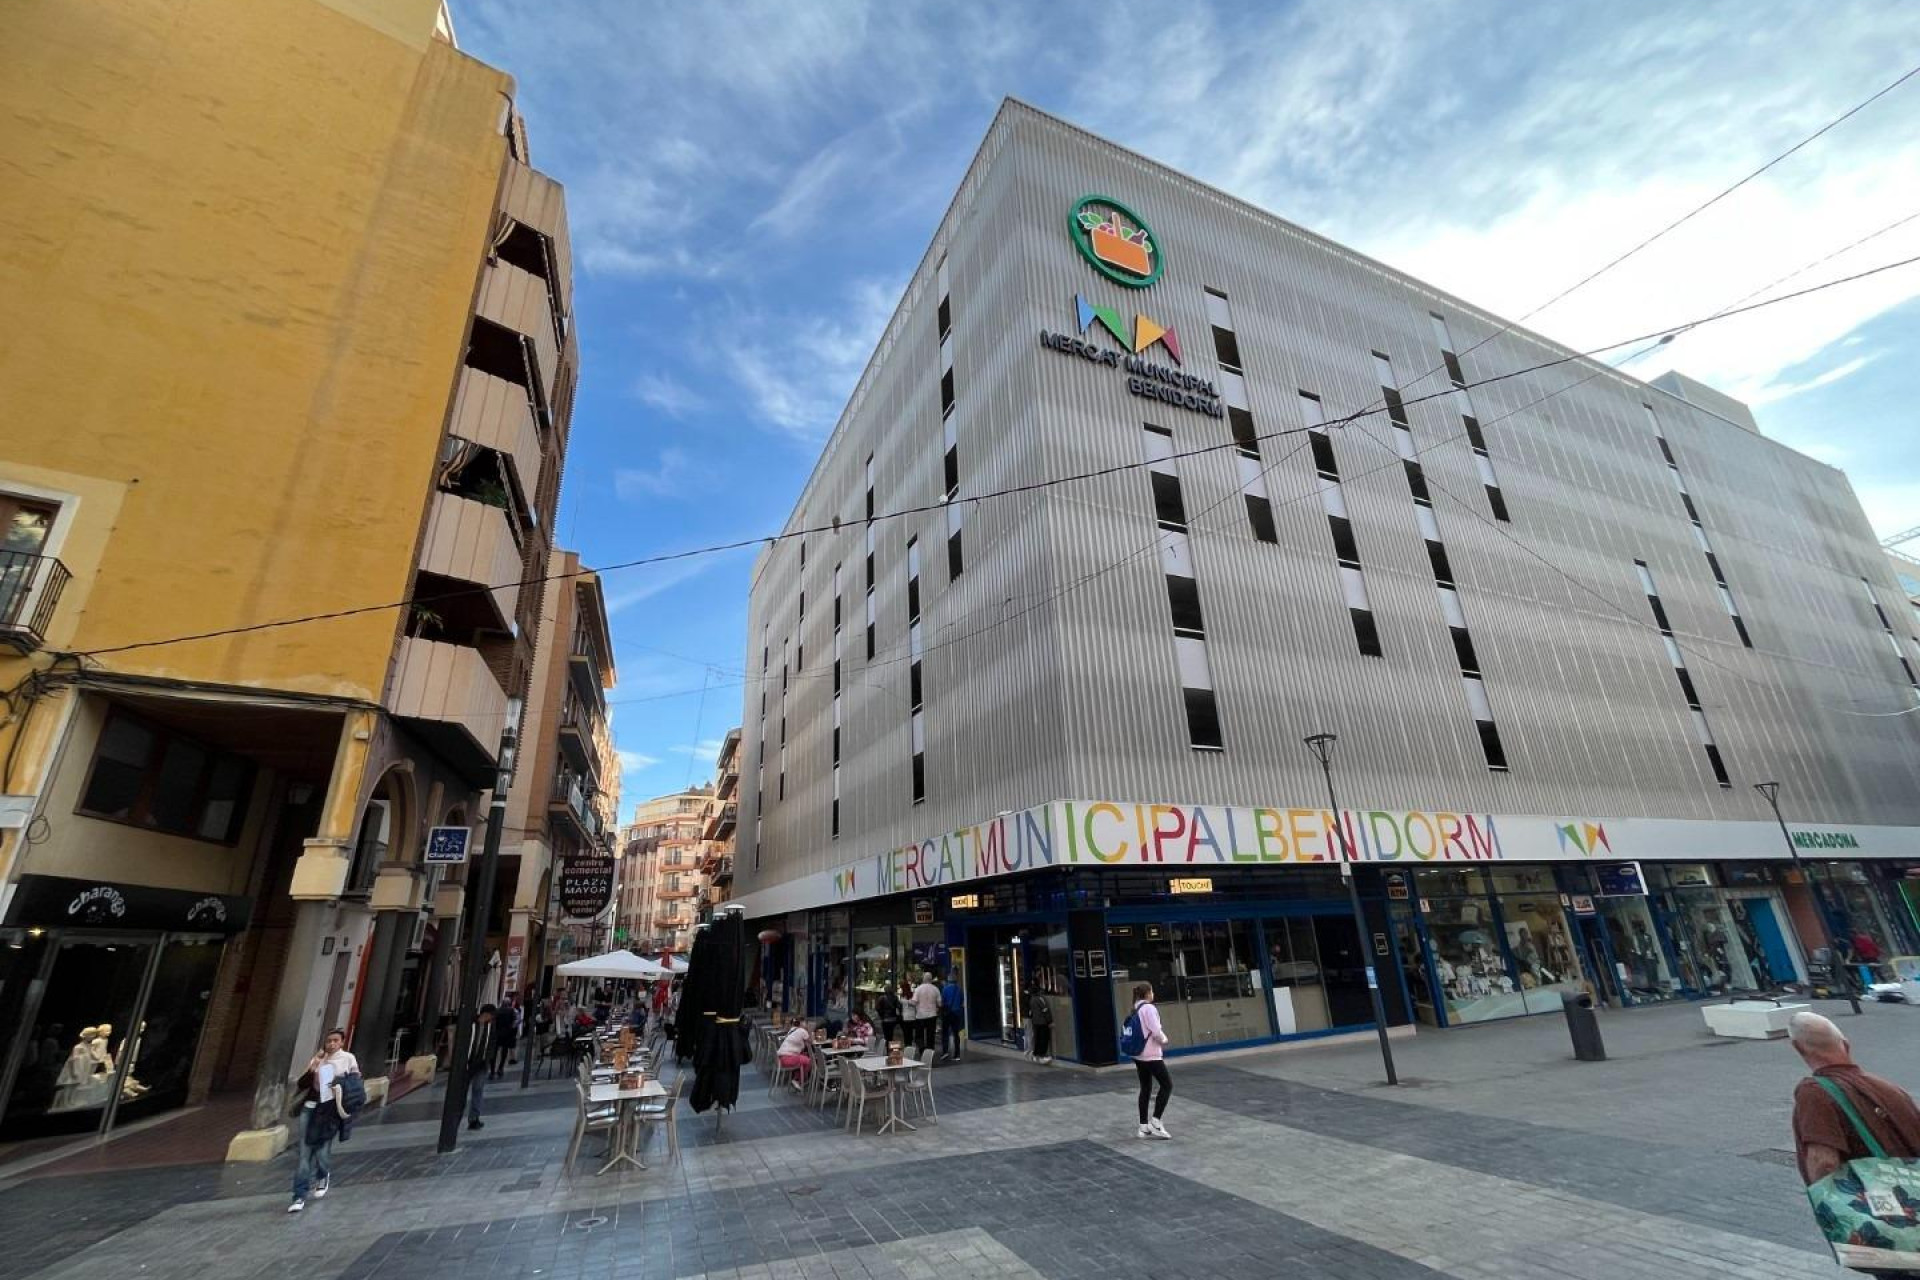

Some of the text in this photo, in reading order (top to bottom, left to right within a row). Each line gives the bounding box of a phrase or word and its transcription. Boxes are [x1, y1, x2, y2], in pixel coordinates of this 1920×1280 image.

[1040, 328, 1220, 398] MERCAT MUNICIPAL
[1128, 376, 1223, 418] BENIDORM
[1792, 831, 1860, 848] MERCADONA
[574, 859, 605, 867] centro
[564, 866, 612, 874] comercial
[566, 878, 607, 886] PLAZA
[564, 886, 607, 894] MAYOR
